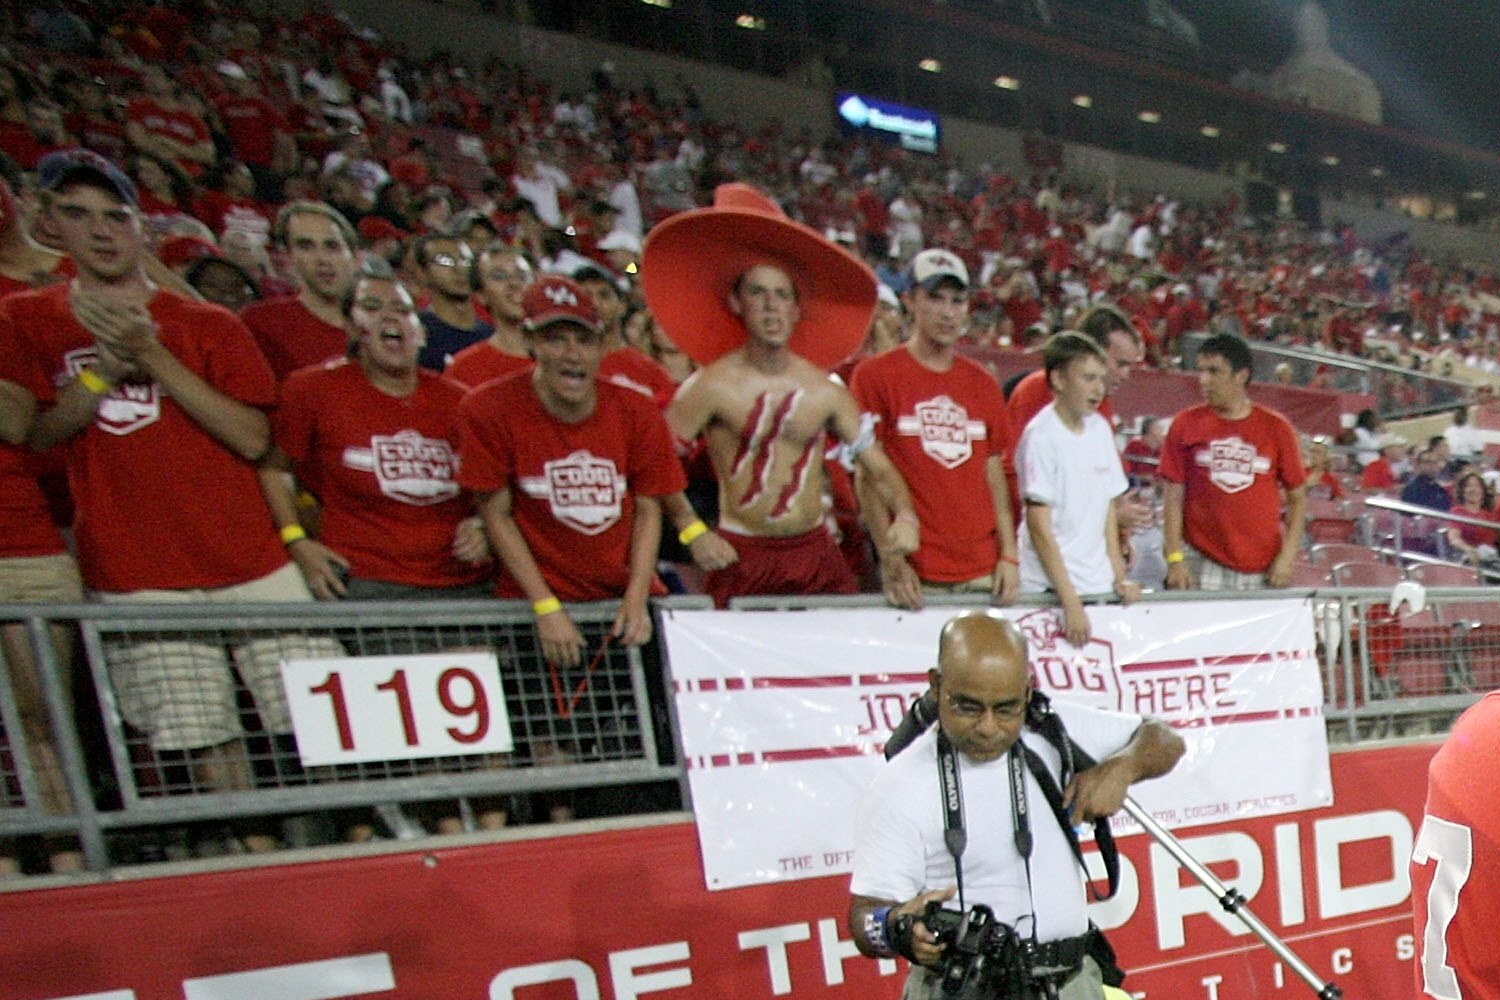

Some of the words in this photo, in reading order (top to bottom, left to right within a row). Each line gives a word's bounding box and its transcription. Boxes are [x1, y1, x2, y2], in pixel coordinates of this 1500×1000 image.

[310, 666, 490, 751] 119
[1129, 671, 1237, 715] HERE
[943, 753, 960, 812] OLYMPUS
[1012, 757, 1027, 816] OLYMPUS
[778, 855, 814, 872] THE
[737, 918, 897, 997] TH
[1086, 808, 1414, 950] PRID
